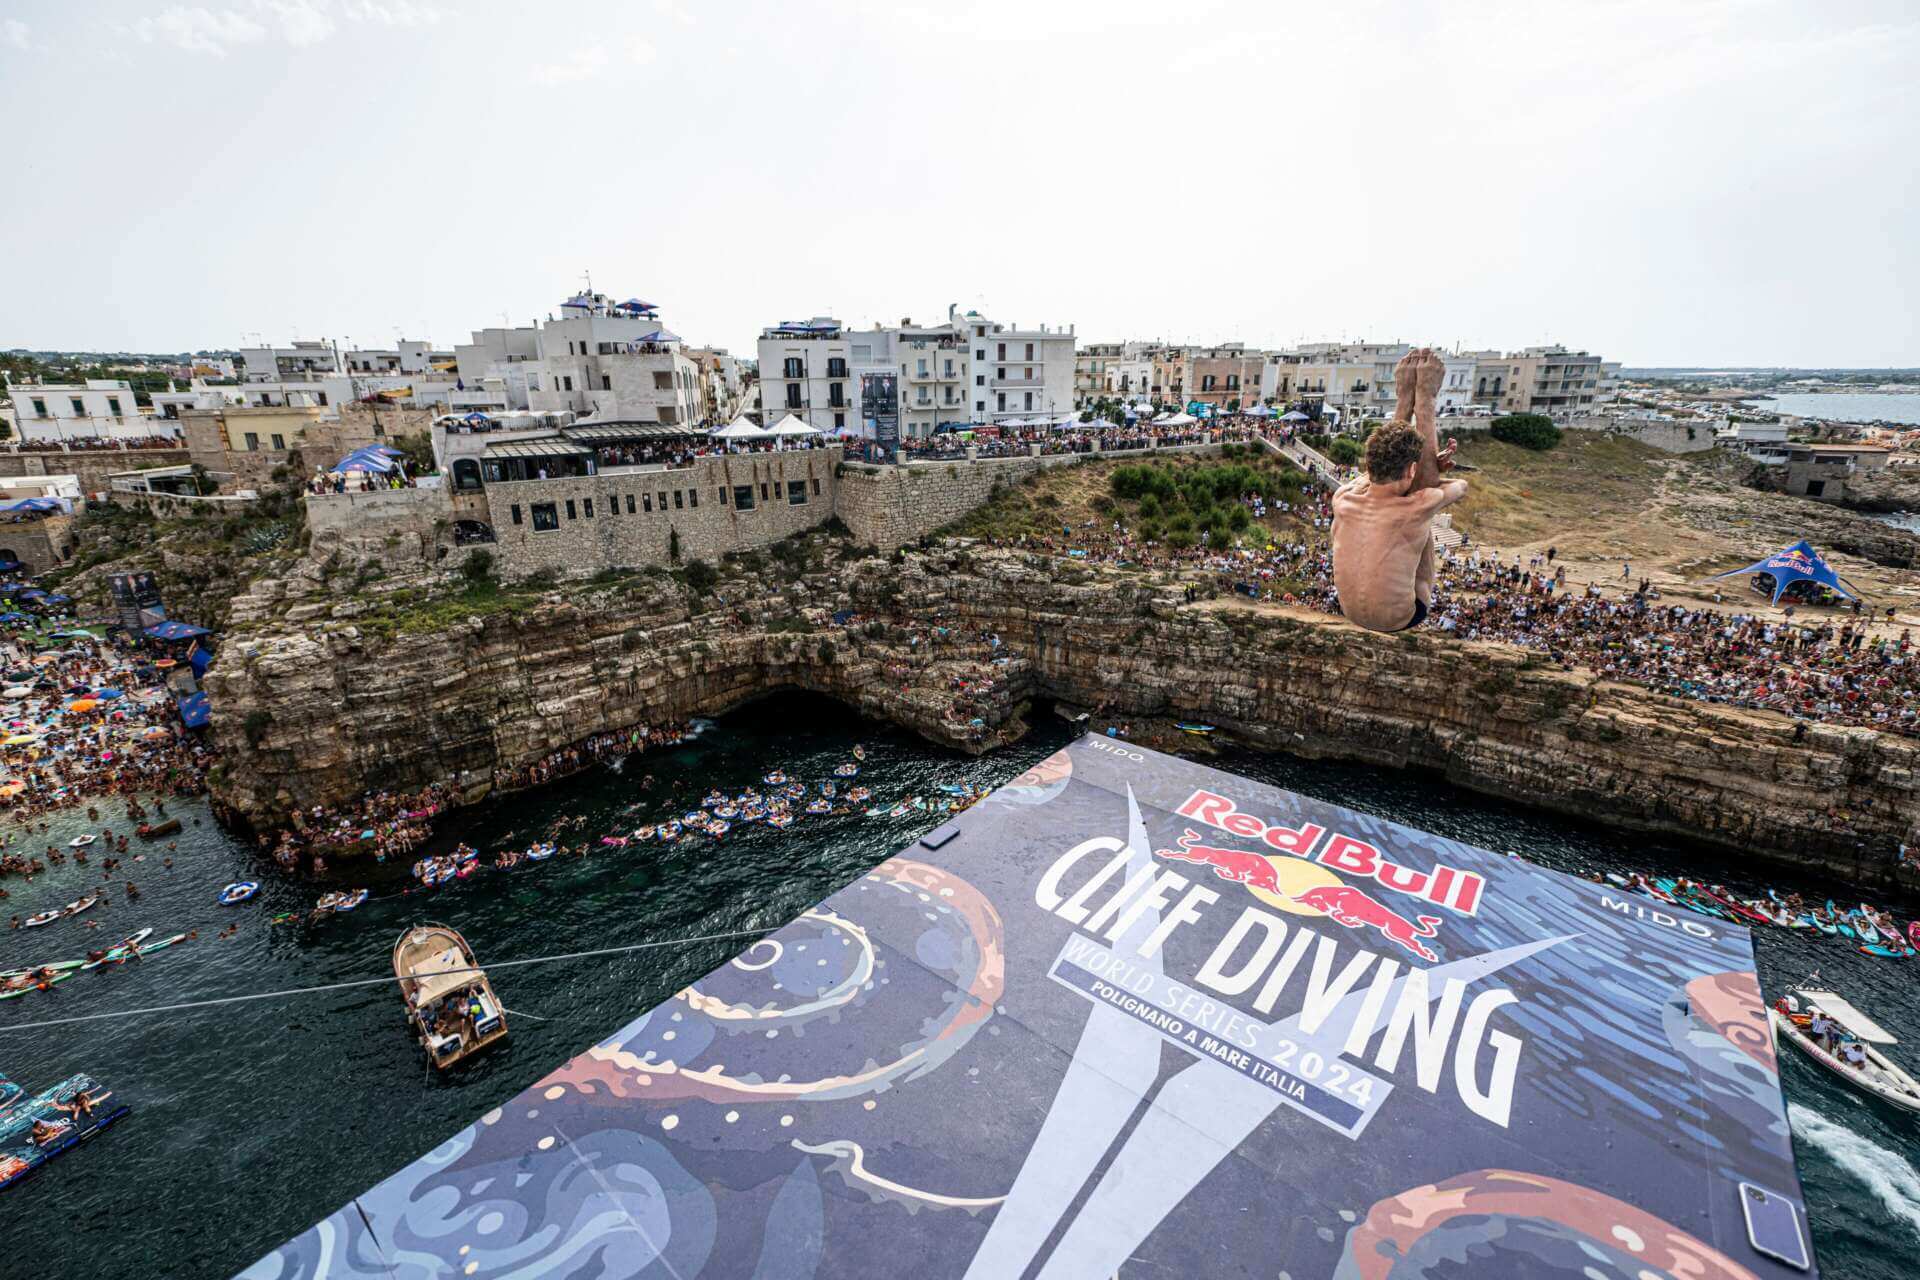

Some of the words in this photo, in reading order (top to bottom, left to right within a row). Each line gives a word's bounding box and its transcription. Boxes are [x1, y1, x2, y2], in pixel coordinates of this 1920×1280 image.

[1174, 789, 1327, 858] Red
[1315, 833, 1487, 917] Bull
[1035, 836, 1222, 959] CLIFF
[1194, 906, 1523, 1128] DIVING
[1066, 938, 1155, 994] WORLD
[1159, 986, 1263, 1048] SERIES
[1271, 1039, 1374, 1106] 2024
[1090, 981, 1183, 1035] POLIGNANO
[1183, 1028, 1198, 1043] A
[1200, 1037, 1251, 1070] MARE
[1252, 1062, 1306, 1101] ITALIA
